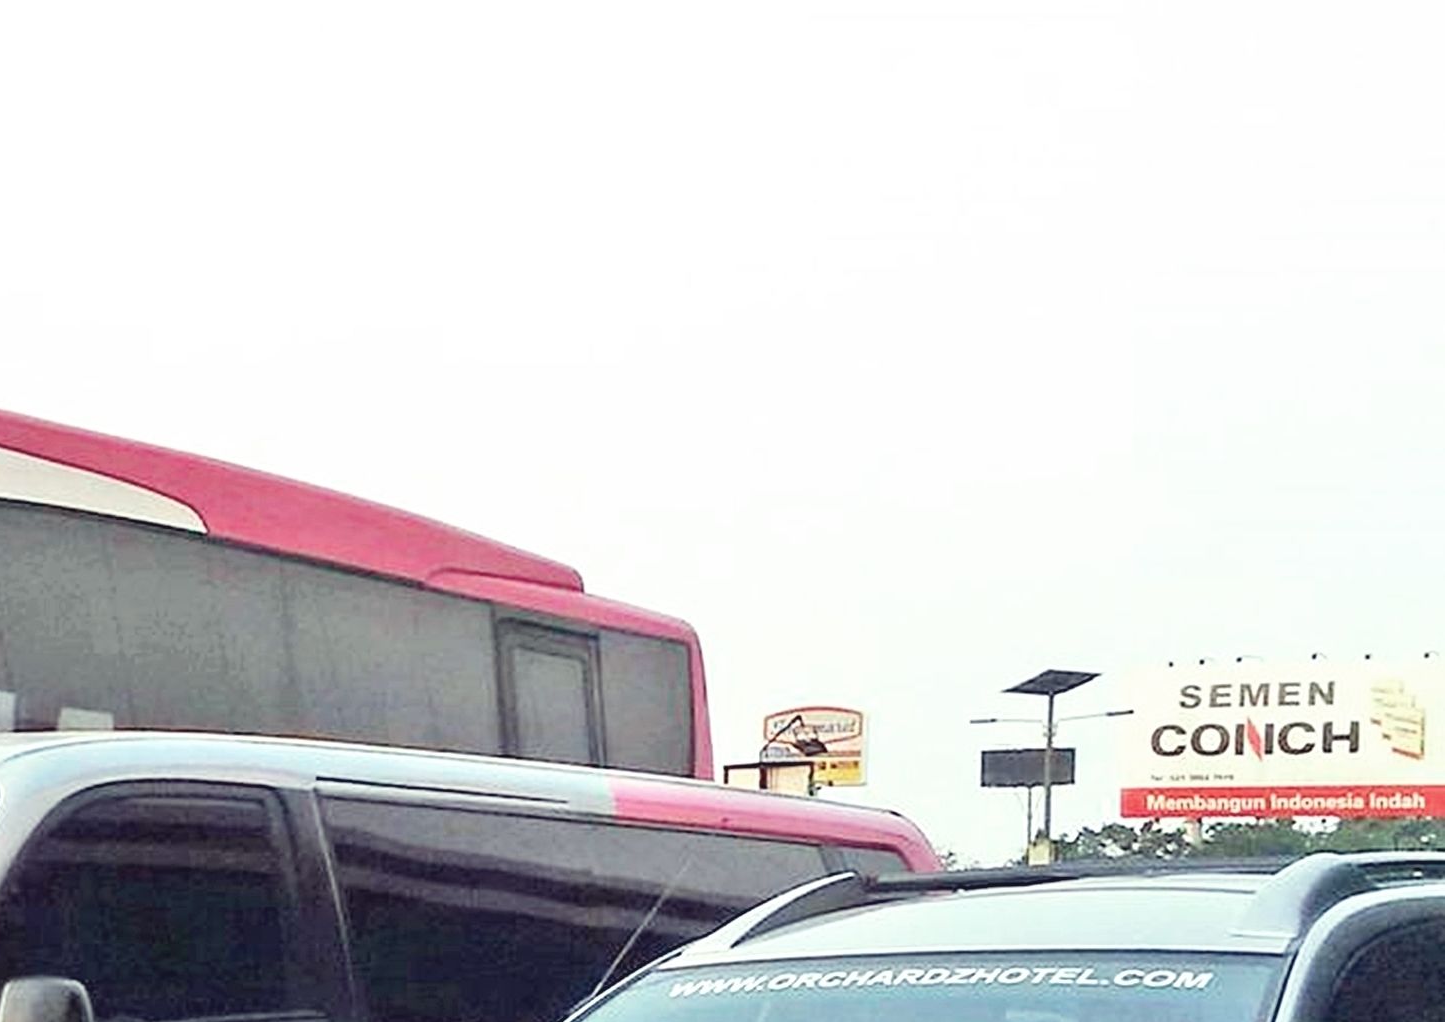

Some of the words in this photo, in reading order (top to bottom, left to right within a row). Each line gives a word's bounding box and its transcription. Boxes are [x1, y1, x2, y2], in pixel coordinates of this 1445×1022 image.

[1179, 681, 1336, 709] SEMEN
[1151, 716, 1361, 762] CONCH
[1146, 794, 1266, 813] Membangun
[1270, 792, 1364, 810] Indonesia
[1369, 791, 1426, 809] Indah
[668, 967, 1214, 998] WWW.ORCHARDZHOTEL.COM
